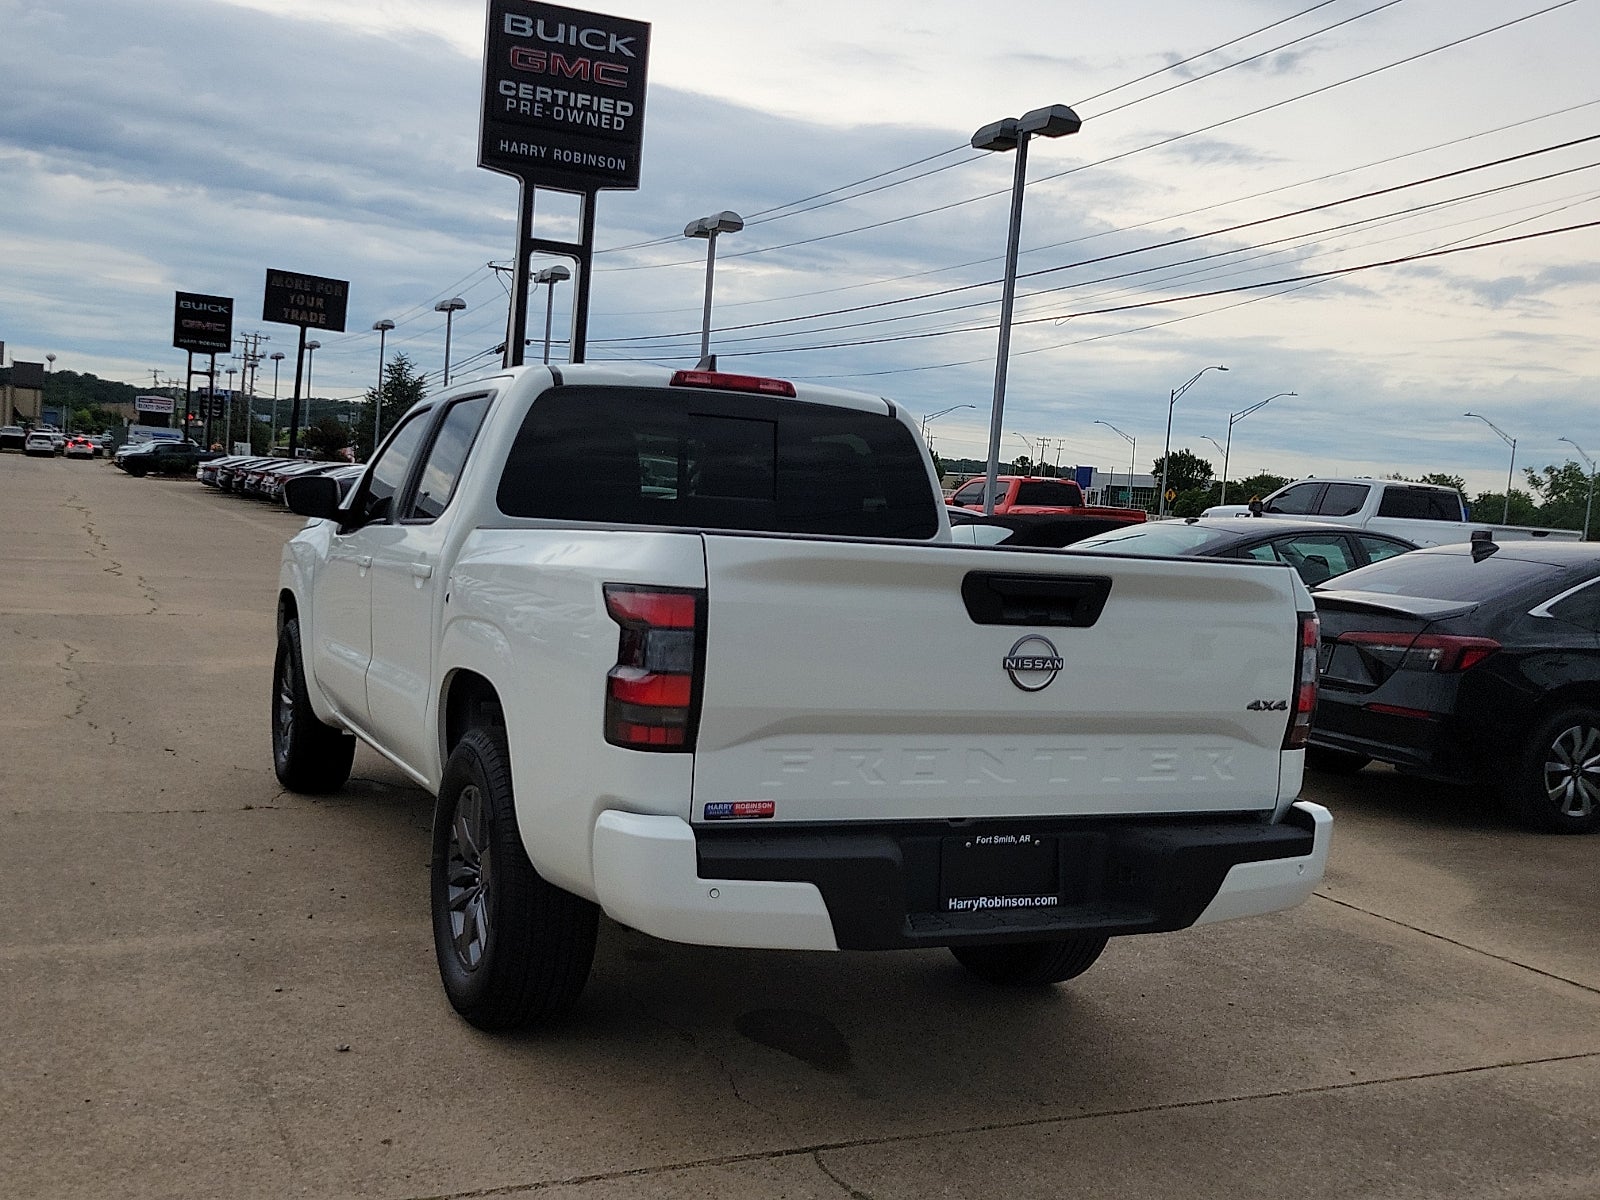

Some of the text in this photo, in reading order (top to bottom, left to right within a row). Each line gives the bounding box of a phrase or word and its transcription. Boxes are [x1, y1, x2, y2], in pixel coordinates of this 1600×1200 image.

[503, 13, 636, 58] BUICK
[510, 46, 629, 88] GMC
[499, 80, 634, 117] CERTIFIED
[506, 98, 625, 131] PRE-OWNED
[499, 139, 626, 171] HARRY ROBINSON
[271, 275, 344, 298] MORE FOR
[179, 299, 230, 314] BUICK
[289, 294, 325, 309] YOUR
[283, 307, 327, 325] TRADE
[1006, 658, 1063, 670] NISSAN
[760, 746, 1236, 787] FRONTIER
[976, 834, 1031, 845] Fort Smith, AR
[948, 895, 1058, 912] HarryRobinson.com
